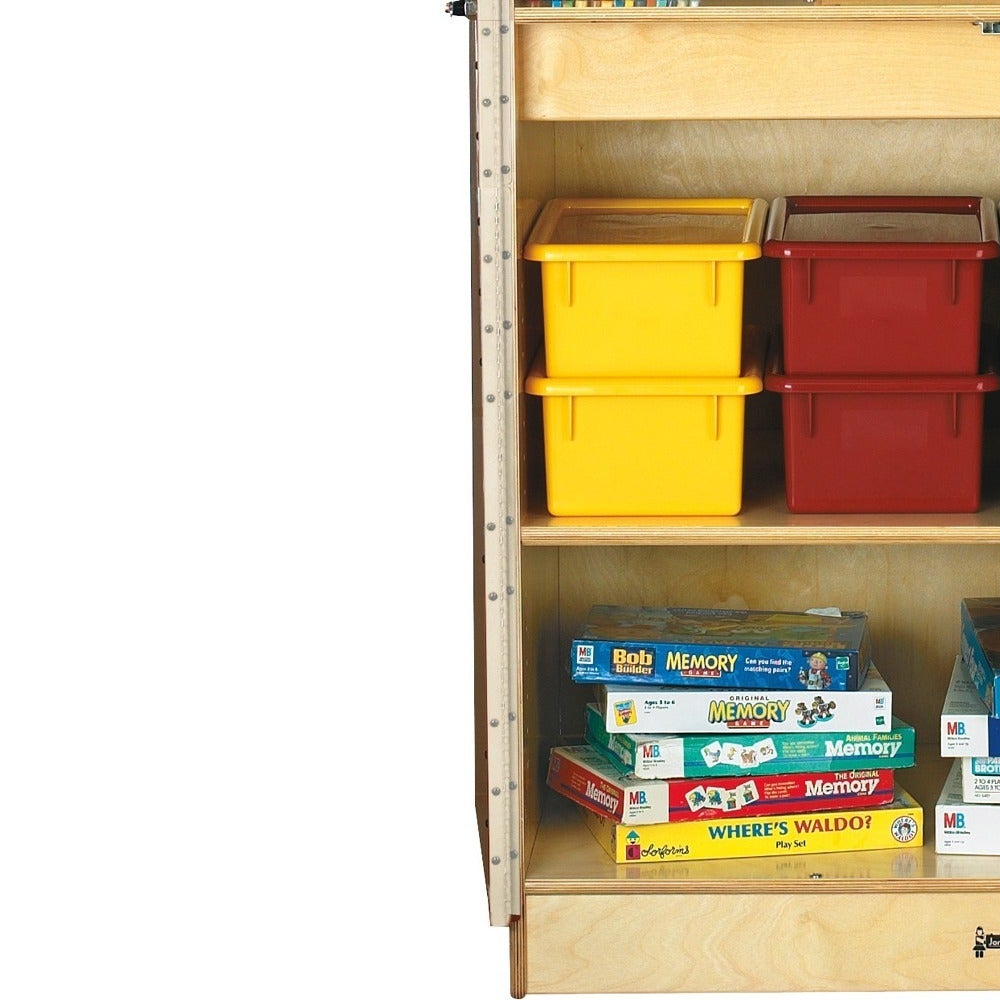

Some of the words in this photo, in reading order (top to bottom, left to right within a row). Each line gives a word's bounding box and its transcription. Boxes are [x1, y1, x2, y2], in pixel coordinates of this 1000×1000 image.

[578, 648, 592, 656] MB
[613, 649, 653, 666] Bob
[666, 651, 738, 673] MEMORY
[745, 657, 757, 665] Can
[758, 658, 769, 666] you
[769, 658, 781, 666] find
[616, 665, 653, 674] Builder
[744, 666, 772, 675] matching
[772, 666, 792, 674] pairs?
[708, 700, 791, 724] MEMORY
[947, 721, 966, 735] MB
[846, 734, 871, 742] ANIMAL
[872, 733, 903, 741] FAMILIES
[643, 745, 661, 758] MB
[824, 740, 903, 758] Memory
[849, 771, 879, 779] ORIGINAL
[805, 778, 880, 798] Memory
[585, 780, 619, 815] Memory
[629, 791, 647, 804] MB
[708, 821, 789, 839] WHERE'S
[794, 815, 872, 835] WALDO?
[944, 813, 966, 828] MB
[775, 840, 793, 849] Play
[793, 839, 807, 848] Set
